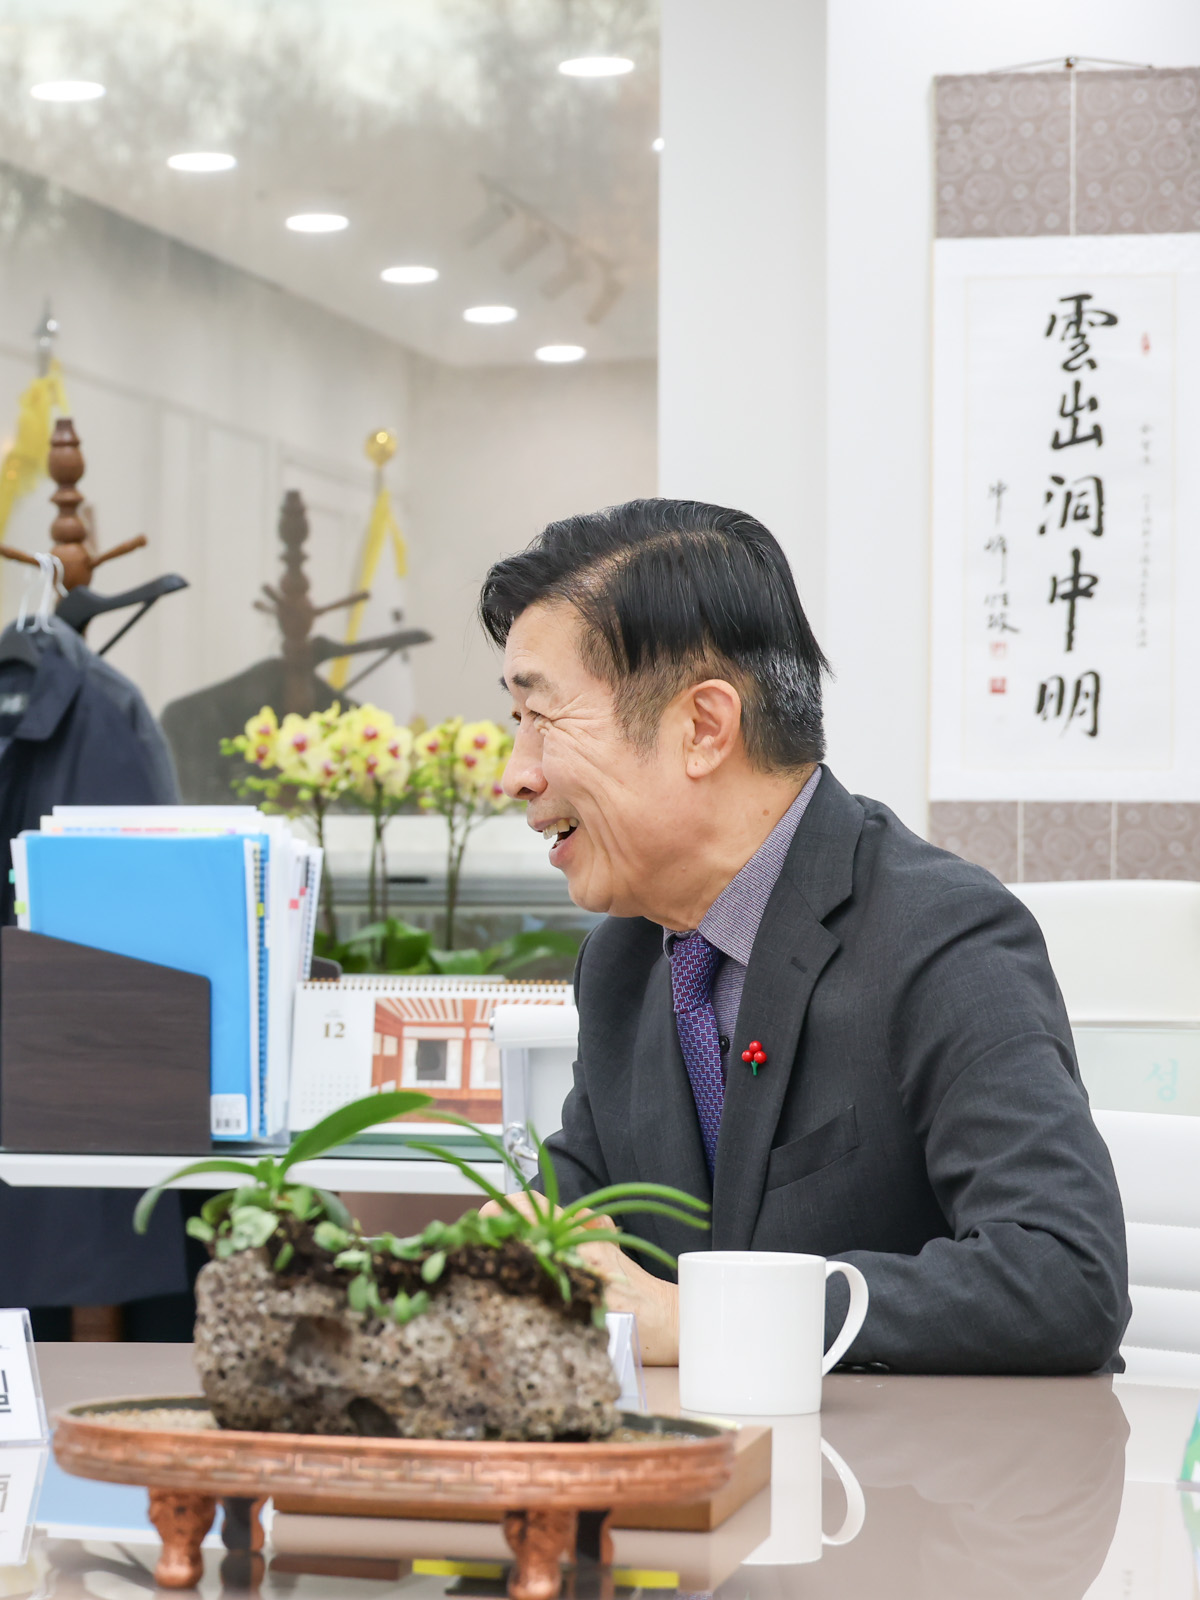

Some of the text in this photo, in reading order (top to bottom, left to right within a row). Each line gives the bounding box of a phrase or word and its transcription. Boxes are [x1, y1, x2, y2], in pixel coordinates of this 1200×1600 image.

[1034, 292, 1119, 739] 雲出洞中明
[324, 1022, 345, 1039] 12
